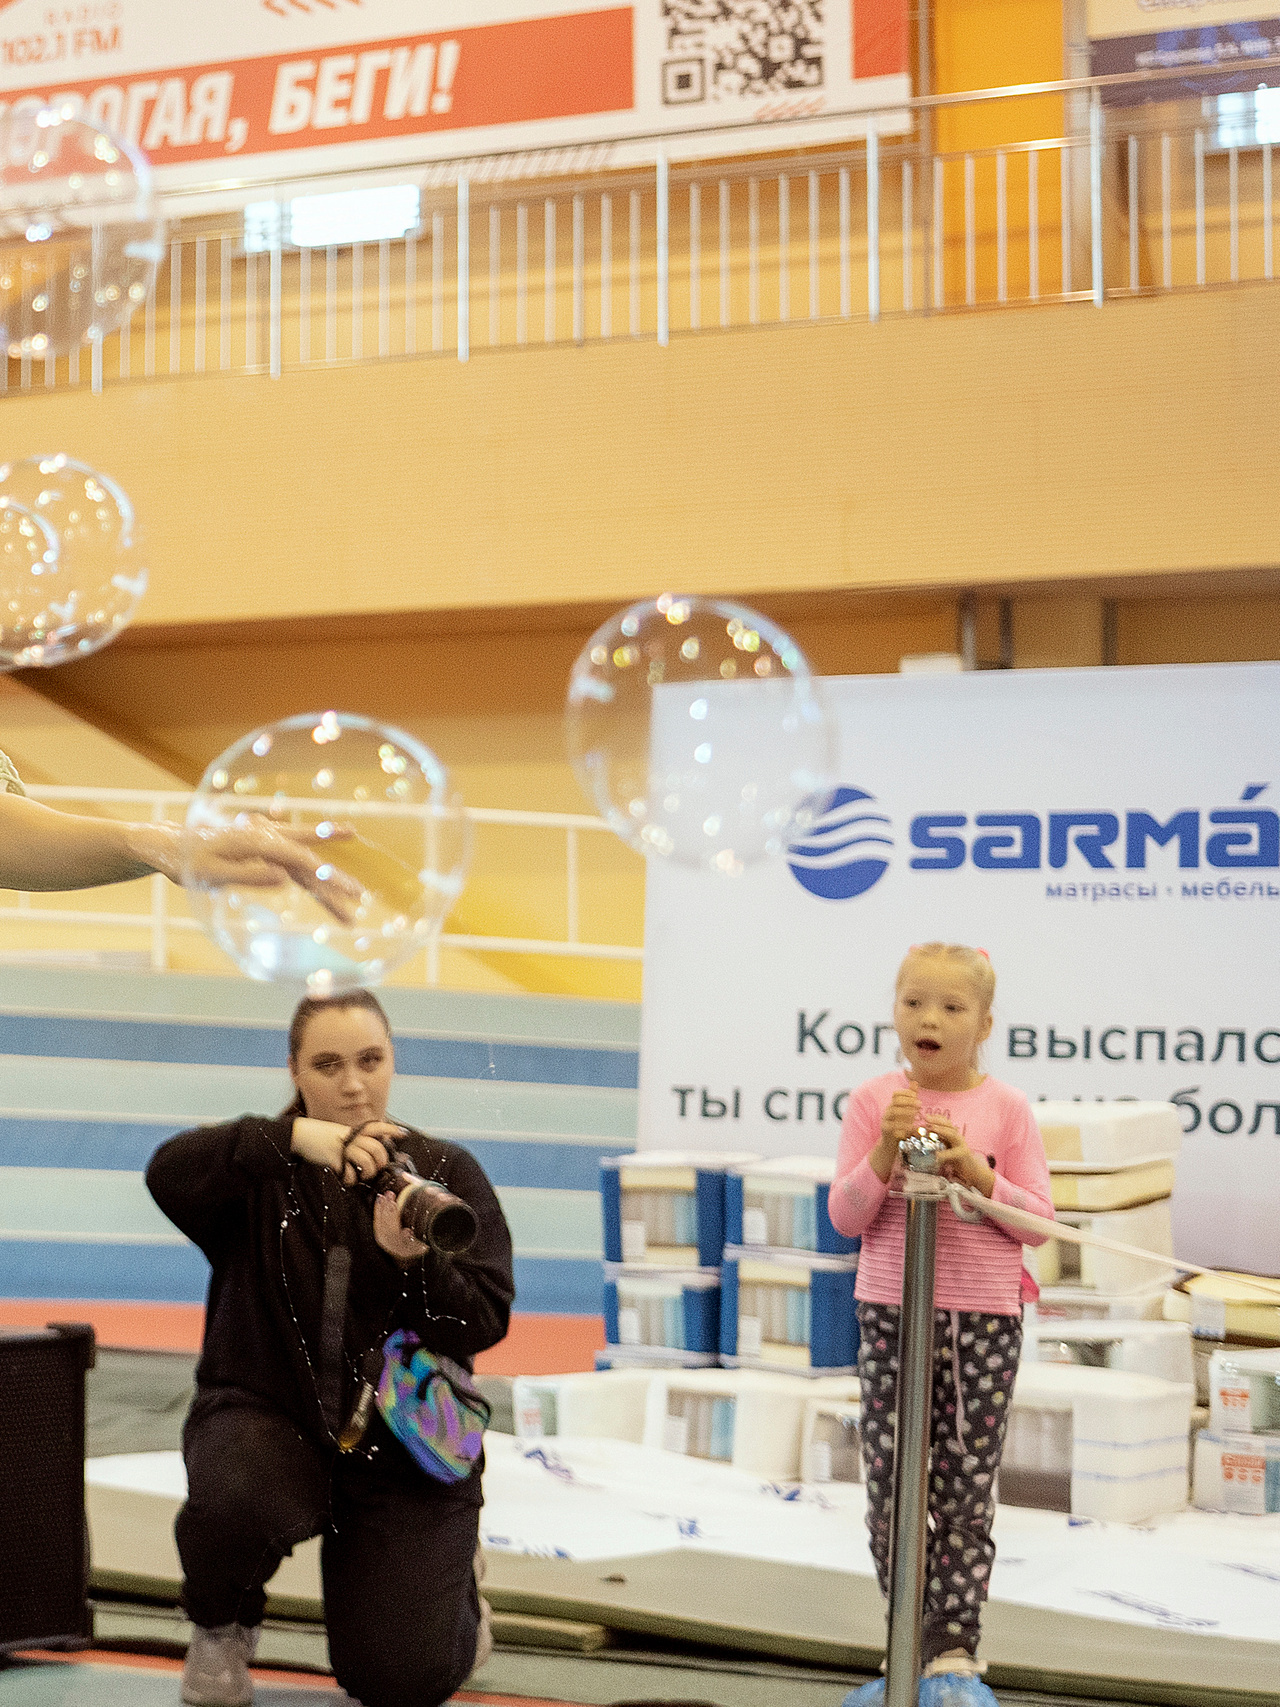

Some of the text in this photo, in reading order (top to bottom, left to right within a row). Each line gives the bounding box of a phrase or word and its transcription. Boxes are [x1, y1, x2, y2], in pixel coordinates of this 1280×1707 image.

[74, 26, 121, 57] FM
[268, 39, 461, 136] БЕГИ!
[1045, 880, 1158, 904] матрасы
[797, 1009, 896, 1056] Ког
[673, 1086, 740, 1119] ты
